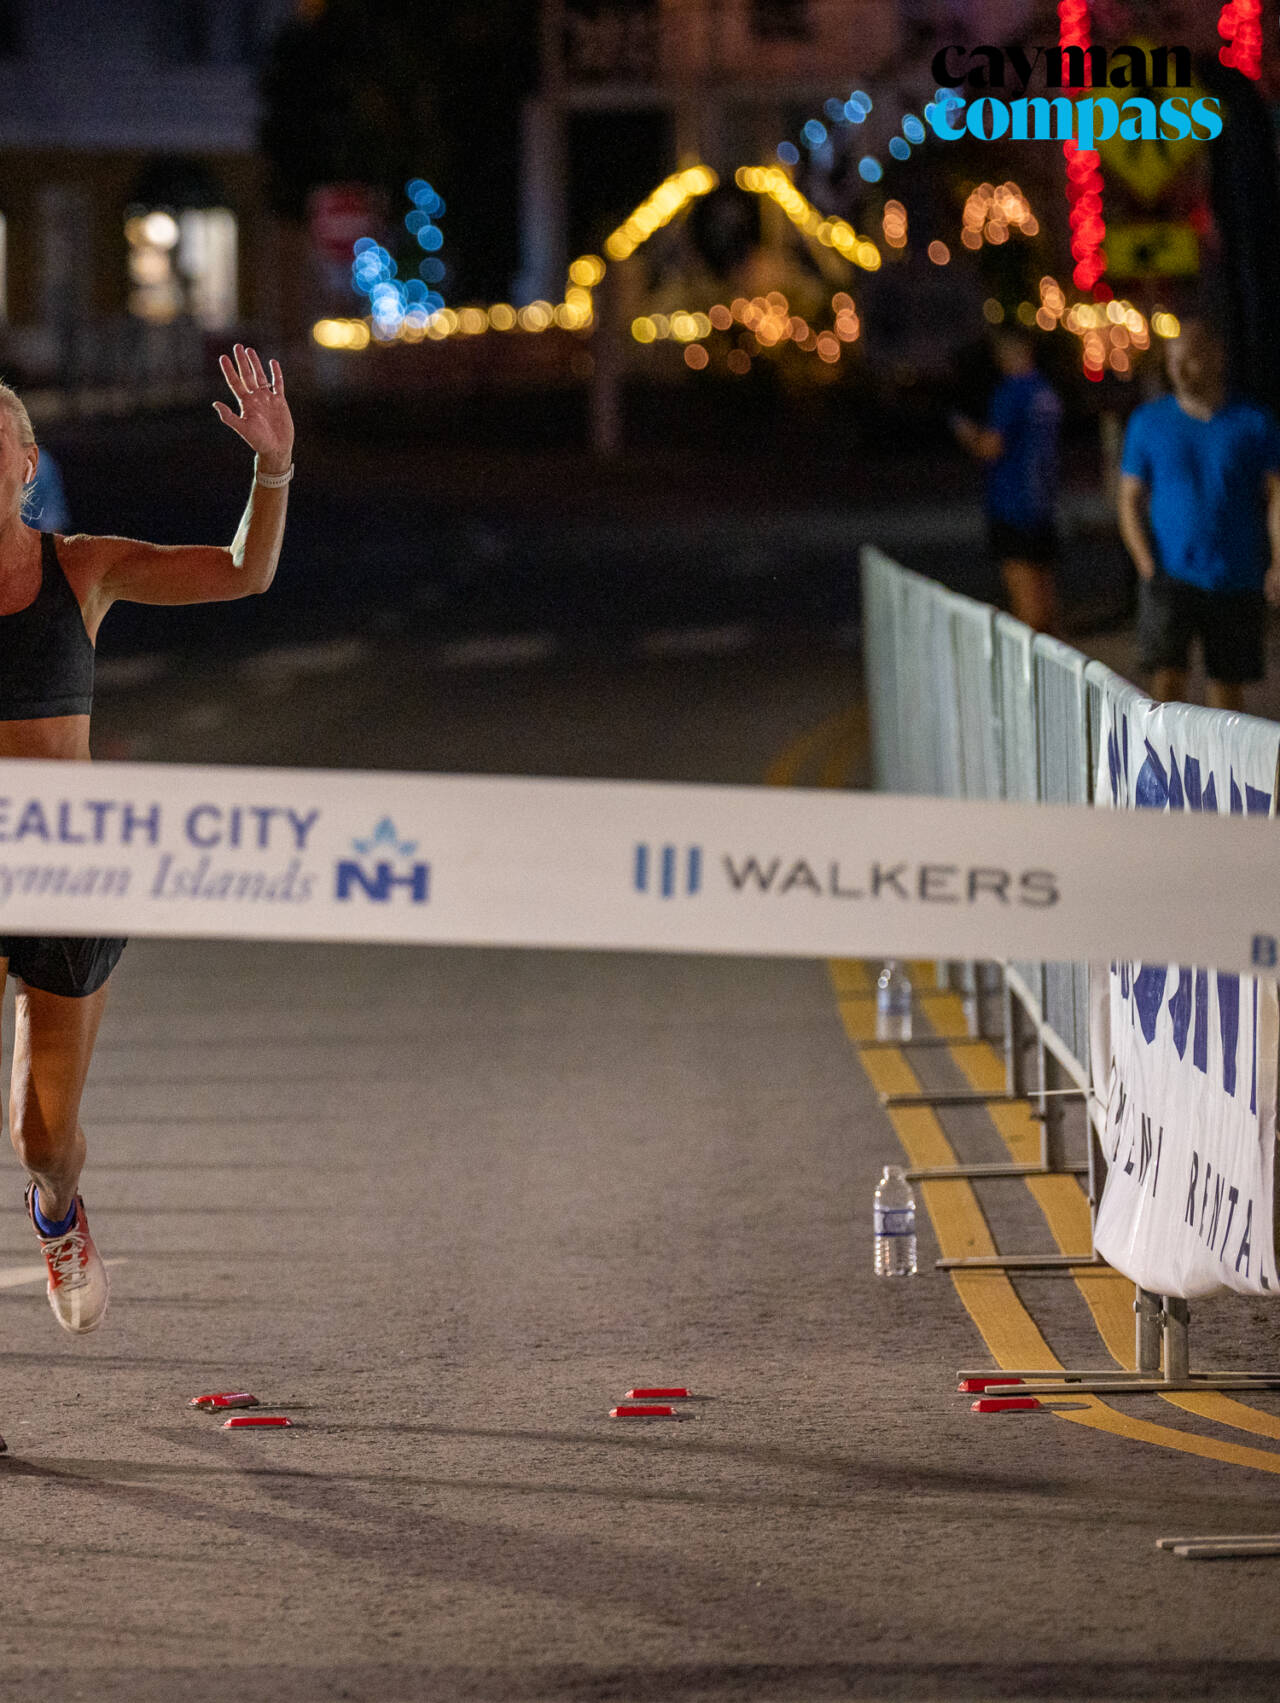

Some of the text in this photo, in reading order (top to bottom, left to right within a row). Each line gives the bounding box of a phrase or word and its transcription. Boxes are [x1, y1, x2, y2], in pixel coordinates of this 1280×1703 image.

[184, 803, 320, 850] CITY
[151, 853, 318, 901] Islands
[333, 860, 430, 904] NH
[723, 854, 1061, 909] WALKERS
